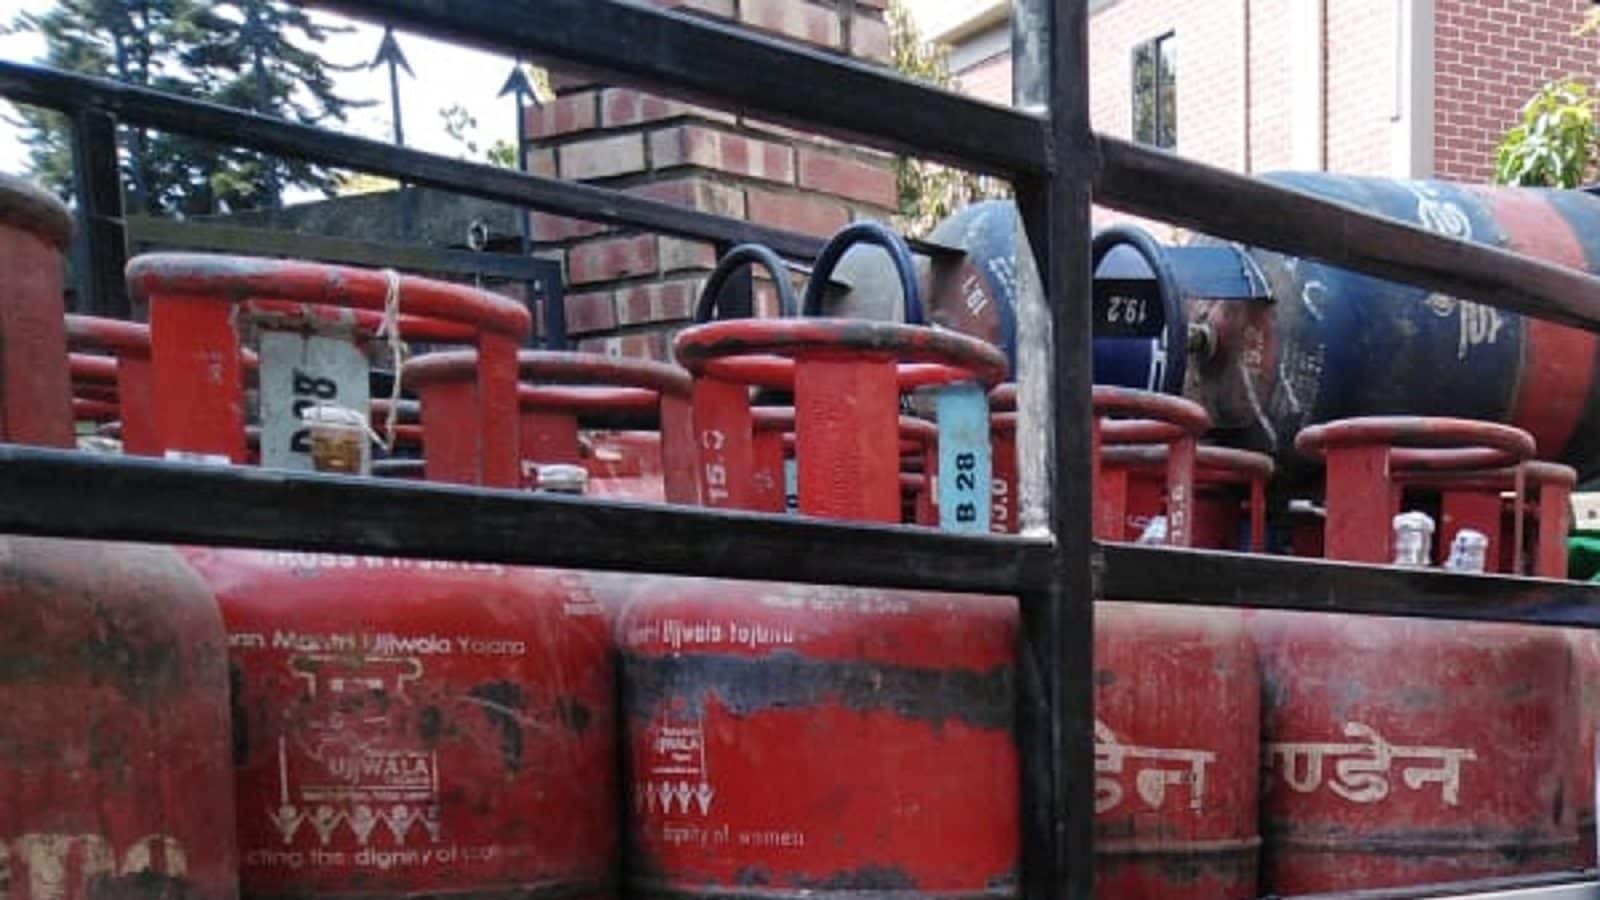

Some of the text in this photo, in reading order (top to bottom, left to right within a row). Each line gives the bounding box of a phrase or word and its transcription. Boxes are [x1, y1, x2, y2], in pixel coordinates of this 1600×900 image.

[1106, 296, 1148, 323] 19.2
[955, 452, 976, 522] B 28
